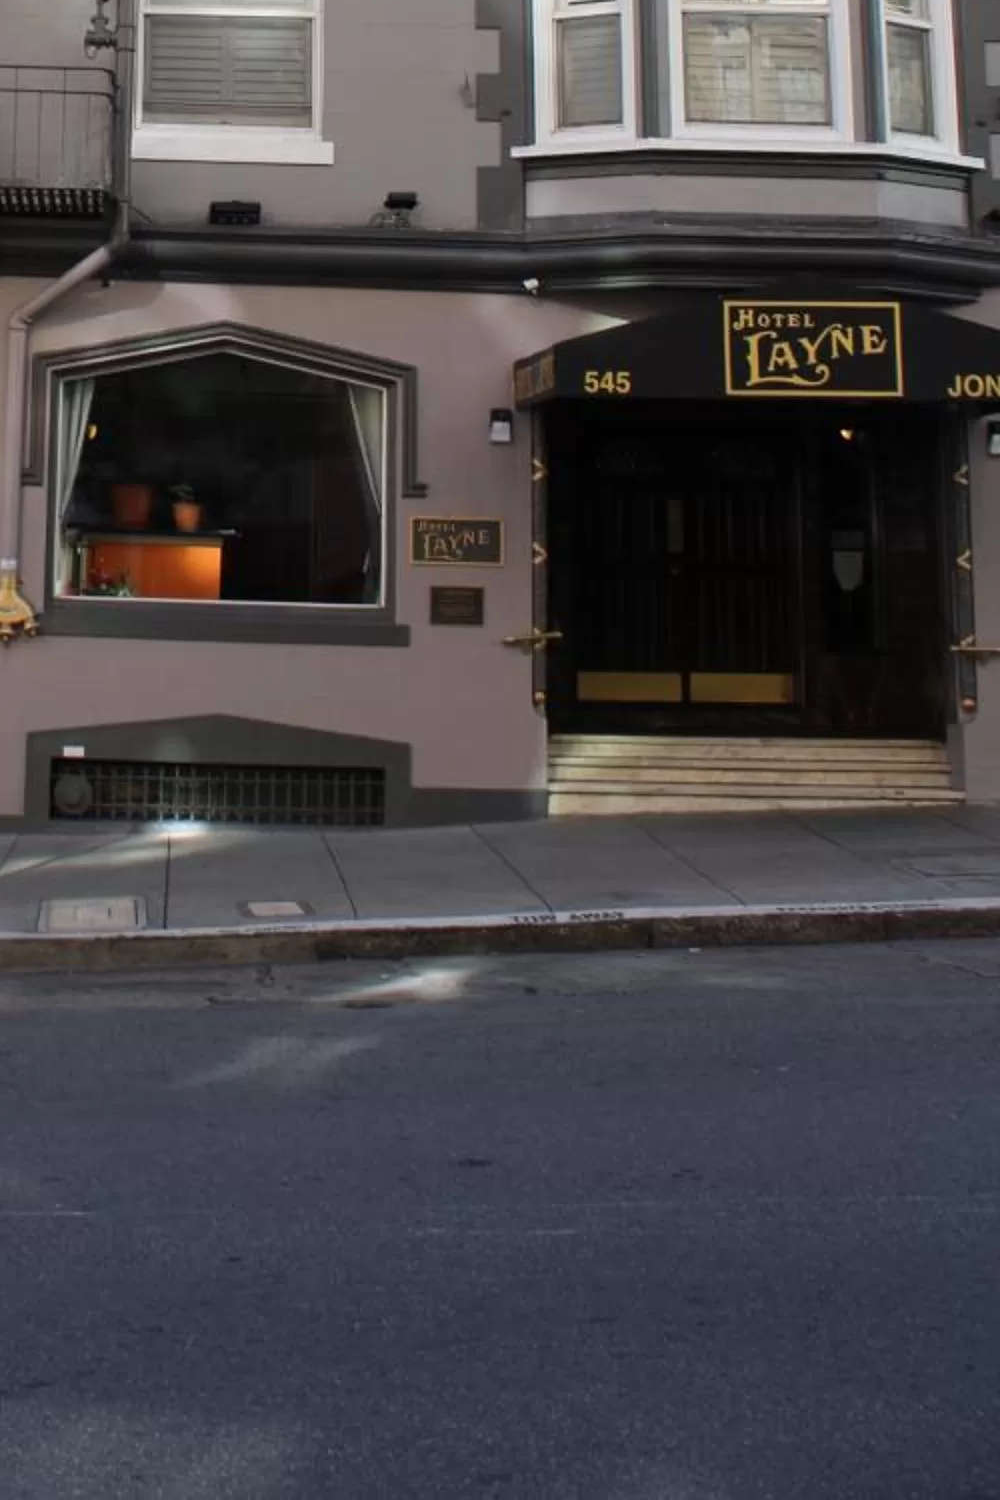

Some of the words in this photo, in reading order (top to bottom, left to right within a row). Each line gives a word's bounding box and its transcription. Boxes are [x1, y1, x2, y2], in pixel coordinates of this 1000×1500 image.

[733, 309, 815, 330] HOTEL
[743, 324, 888, 386] LAYNE
[583, 371, 631, 394] 545
